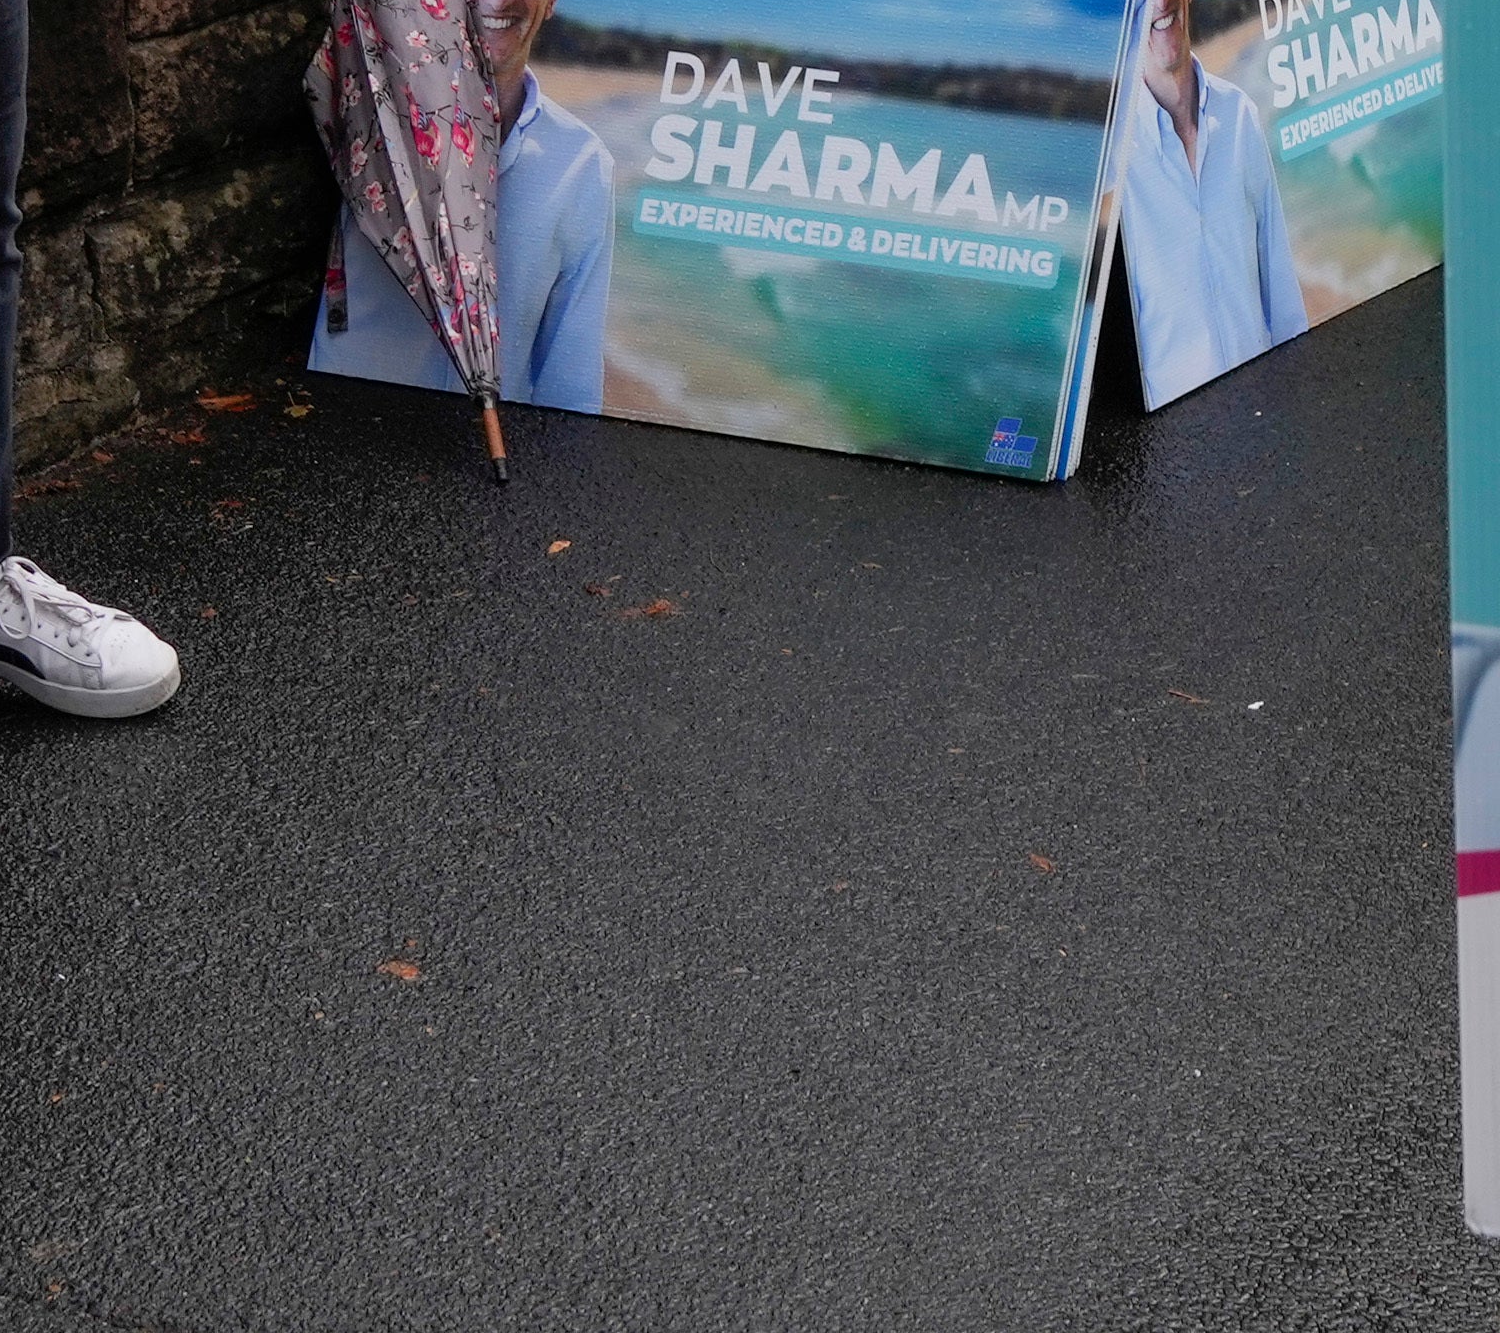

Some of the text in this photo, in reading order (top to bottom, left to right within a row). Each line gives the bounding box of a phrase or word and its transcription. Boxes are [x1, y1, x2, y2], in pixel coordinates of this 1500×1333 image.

[660, 50, 839, 126] DAVE
[1280, 88, 1380, 151] EXPERIENCED
[1384, 85, 1398, 105] &
[645, 116, 1070, 232] SHARMA MP
[639, 197, 1056, 277] EXPERIENCED & DELIVERING
[985, 449, 1033, 468] LIBERAL
